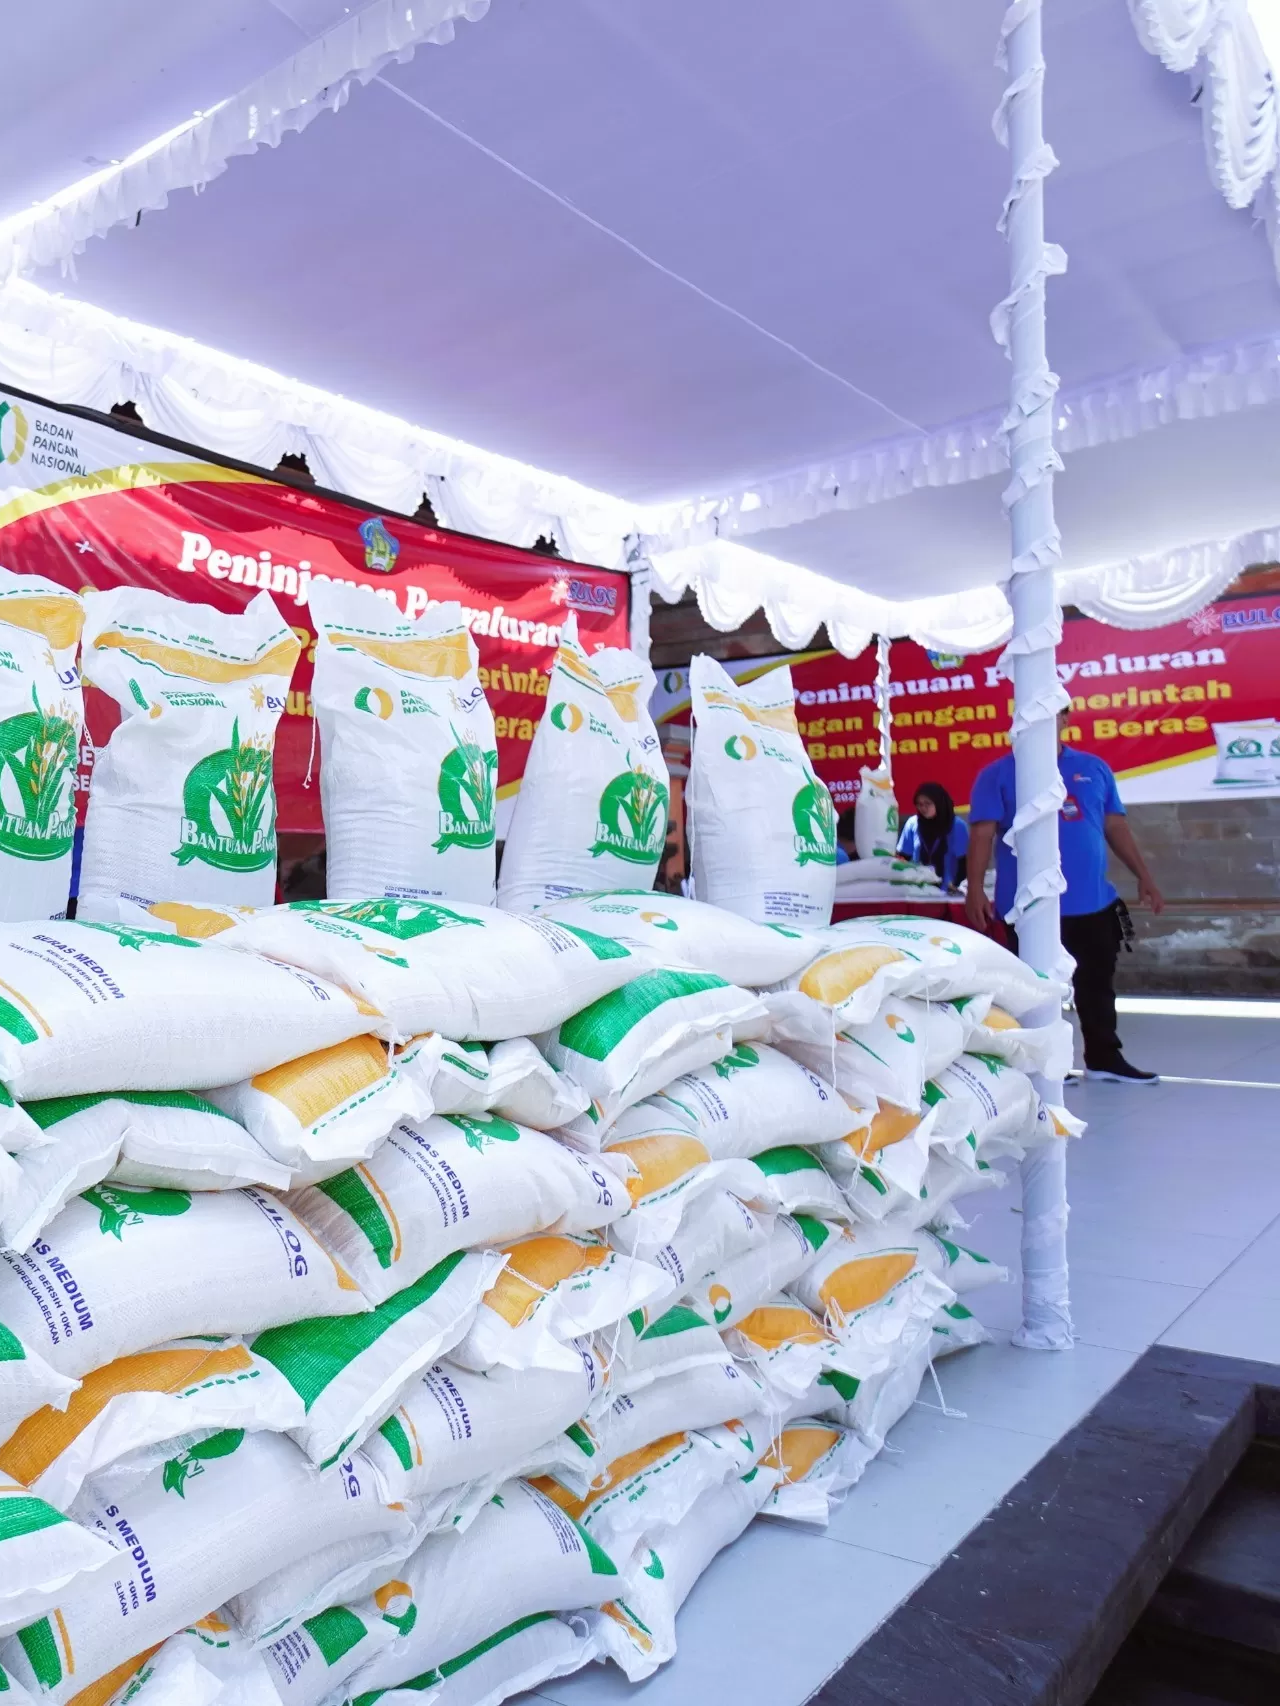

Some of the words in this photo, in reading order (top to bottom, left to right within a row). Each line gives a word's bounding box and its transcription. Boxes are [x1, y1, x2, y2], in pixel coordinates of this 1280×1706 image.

[31, 435, 79, 459] PANGAN
[34, 419, 74, 442] BADAN
[30, 453, 89, 478] NASIONAL
[1222, 606, 1280, 627] BULO
[169, 697, 228, 709] NASIONAL
[1093, 716, 1208, 741] Beras
[180, 816, 252, 854] BANTUAN
[595, 821, 644, 851] BANTUAN
[32, 934, 76, 955] BERAS
[73, 952, 126, 999] MEDIUM
[399, 1124, 440, 1158] BERAS
[438, 1159, 470, 1219] MEDIUM
[415, 1151, 437, 1172] BERAT
[435, 1172, 453, 1201] BERSIH
[665, 1244, 685, 1285] EDIUM
[12, 1264, 60, 1345] DIPERJUALBELIKAN
[20, 1252, 40, 1273] ERAT
[38, 1274, 63, 1309] BERSIH
[59, 1310, 73, 1338] 10KG
[46, 1256, 94, 1331] MEDIUM
[440, 1376, 472, 1438] MEDIUM
[115, 1518, 158, 1603] MEDIUM
[127, 1579, 140, 1610] 10KG
